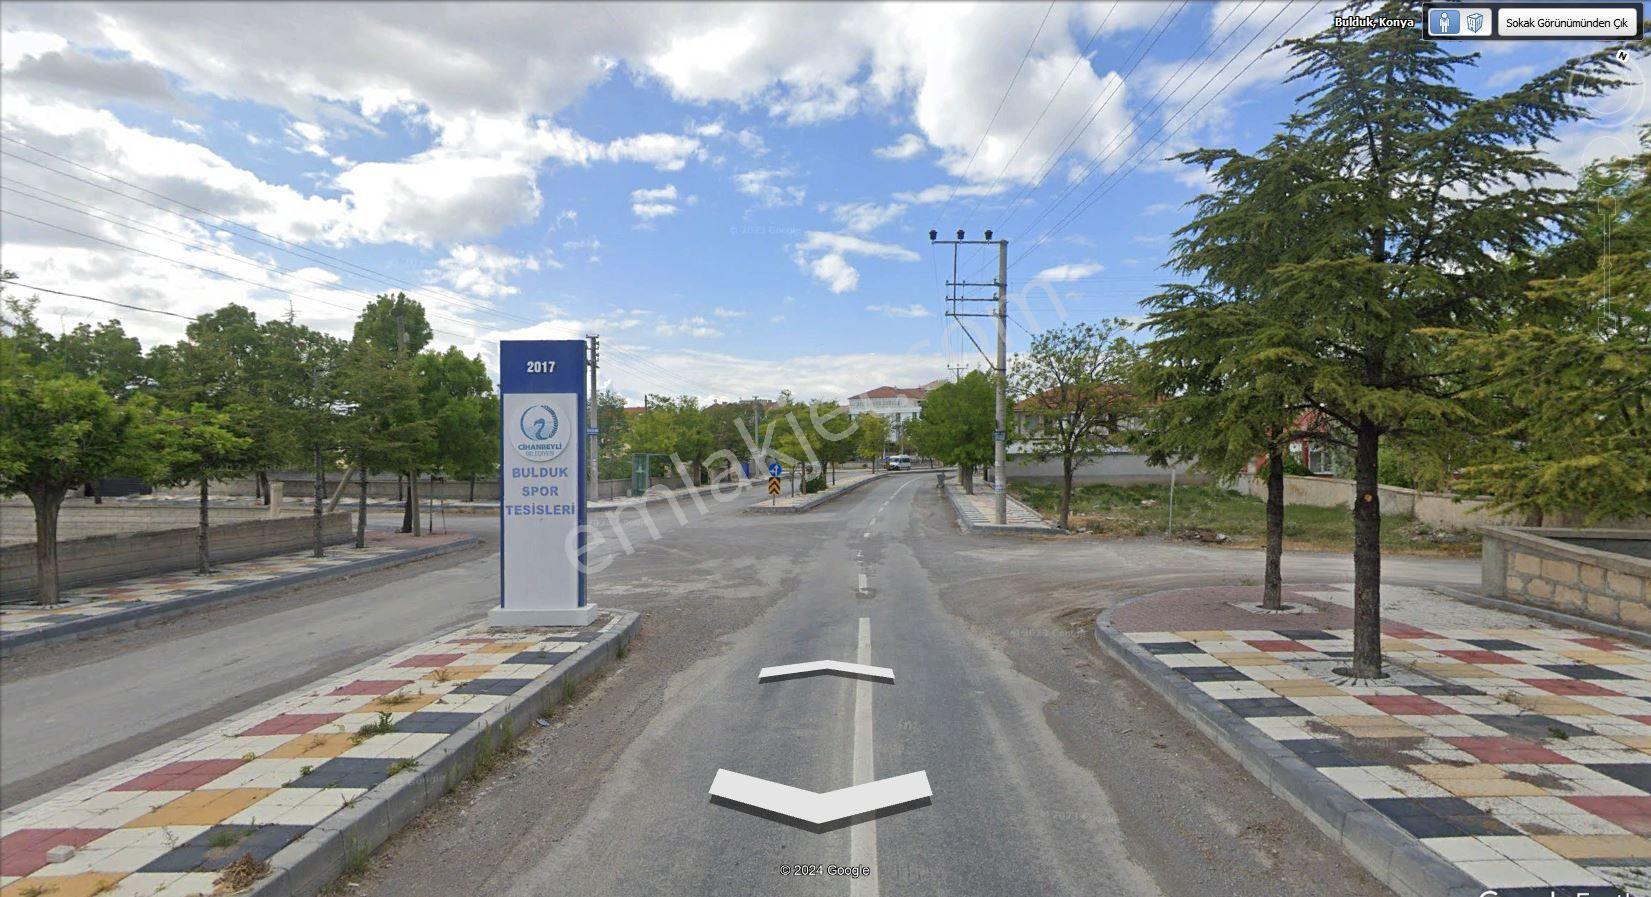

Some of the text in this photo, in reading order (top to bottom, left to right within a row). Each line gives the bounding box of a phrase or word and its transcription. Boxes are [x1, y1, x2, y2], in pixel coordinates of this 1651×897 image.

[526, 360, 556, 373] 2017
[512, 467, 569, 478] BULDUK
[522, 486, 559, 497] SPOR
[505, 502, 576, 516] TESİSLERİ
